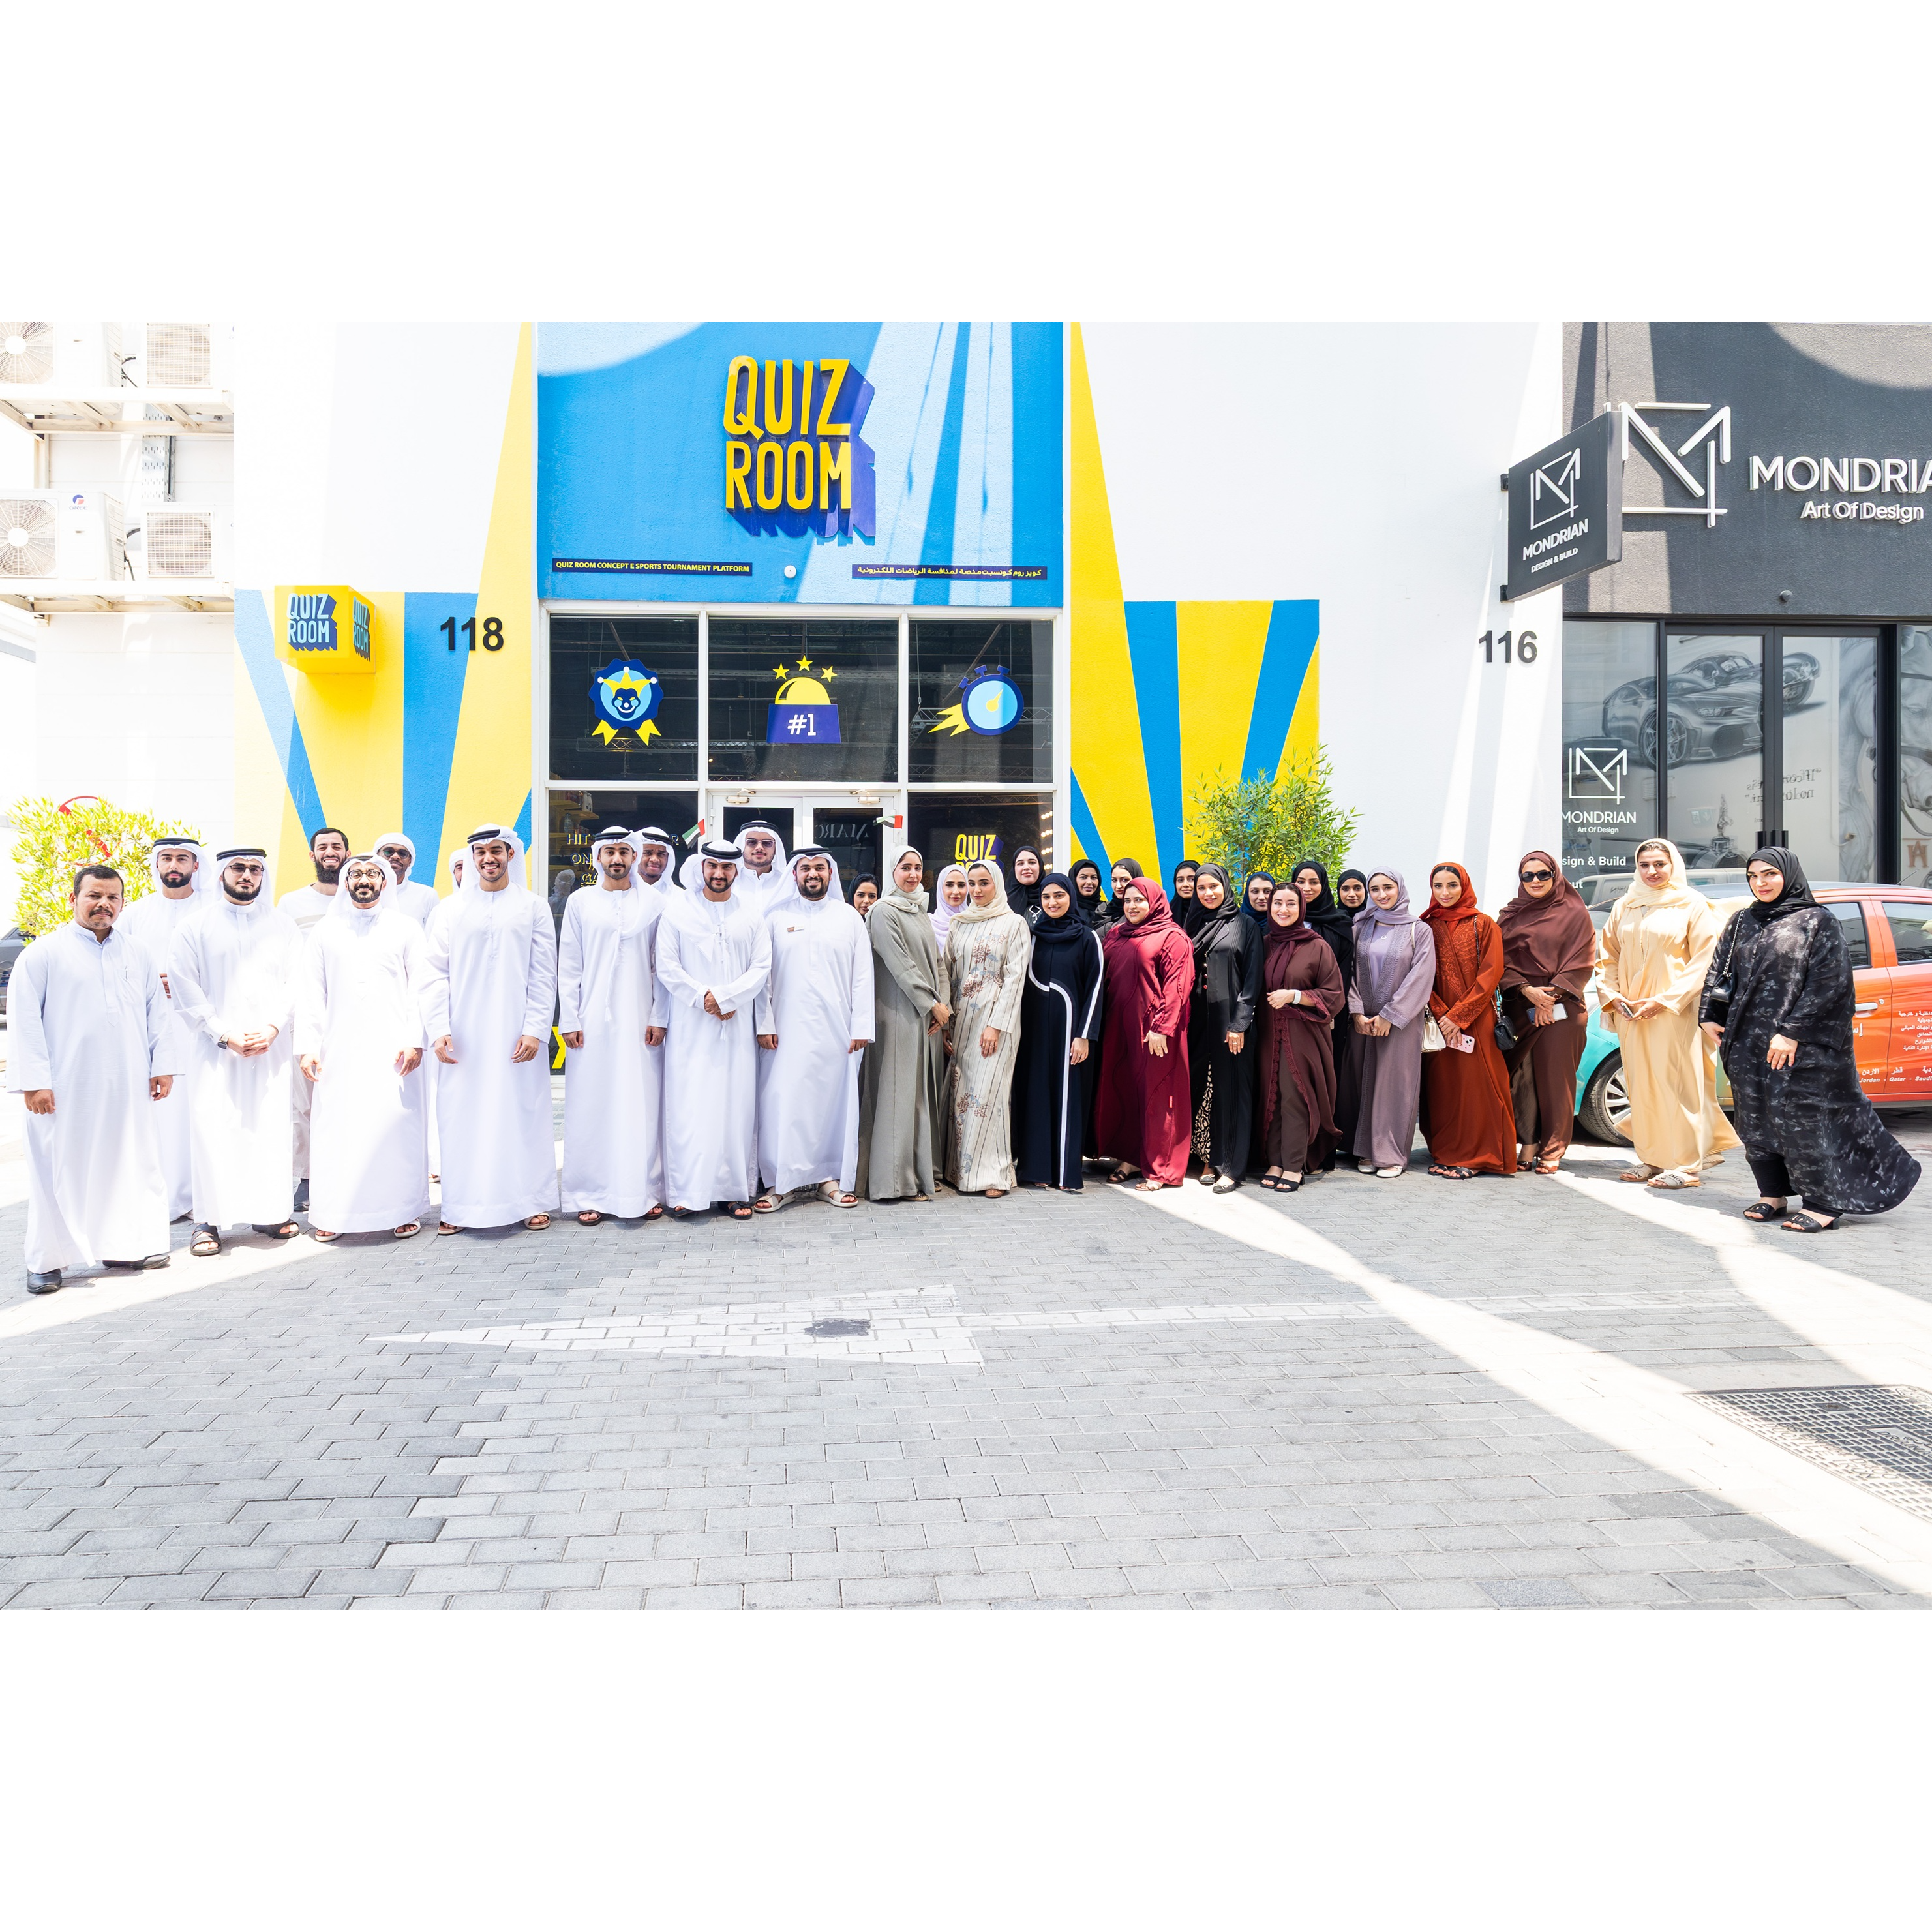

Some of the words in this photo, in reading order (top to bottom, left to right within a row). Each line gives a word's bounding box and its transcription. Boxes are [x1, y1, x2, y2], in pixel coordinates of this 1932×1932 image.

[723, 355, 851, 440] QUIZ
[725, 440, 851, 510] ROOM
[1801, 500, 1831, 519] Art
[1833, 501, 1859, 519] Of
[1860, 502, 1924, 524] Design
[1522, 518, 1589, 561] MONDRIAN
[857, 566, 894, 575] اللكترونية
[1531, 557, 1553, 573] DESIGN
[1559, 547, 1578, 561] BUILD
[286, 593, 329, 620] QUIZ
[353, 596, 369, 630] QUIZ
[287, 620, 329, 643] ROOM
[353, 622, 369, 653] ROOM
[440, 616, 504, 652] 118
[1479, 630, 1537, 663] 116
[787, 713, 817, 736] #1
[1562, 811, 1637, 824] MONDRIAN
[567, 834, 590, 845] HIT
[954, 834, 997, 862] QUIZ
[1587, 856, 1596, 866] &
[1599, 856, 1626, 866] Build
[1892, 1066, 1903, 1075] قطر
